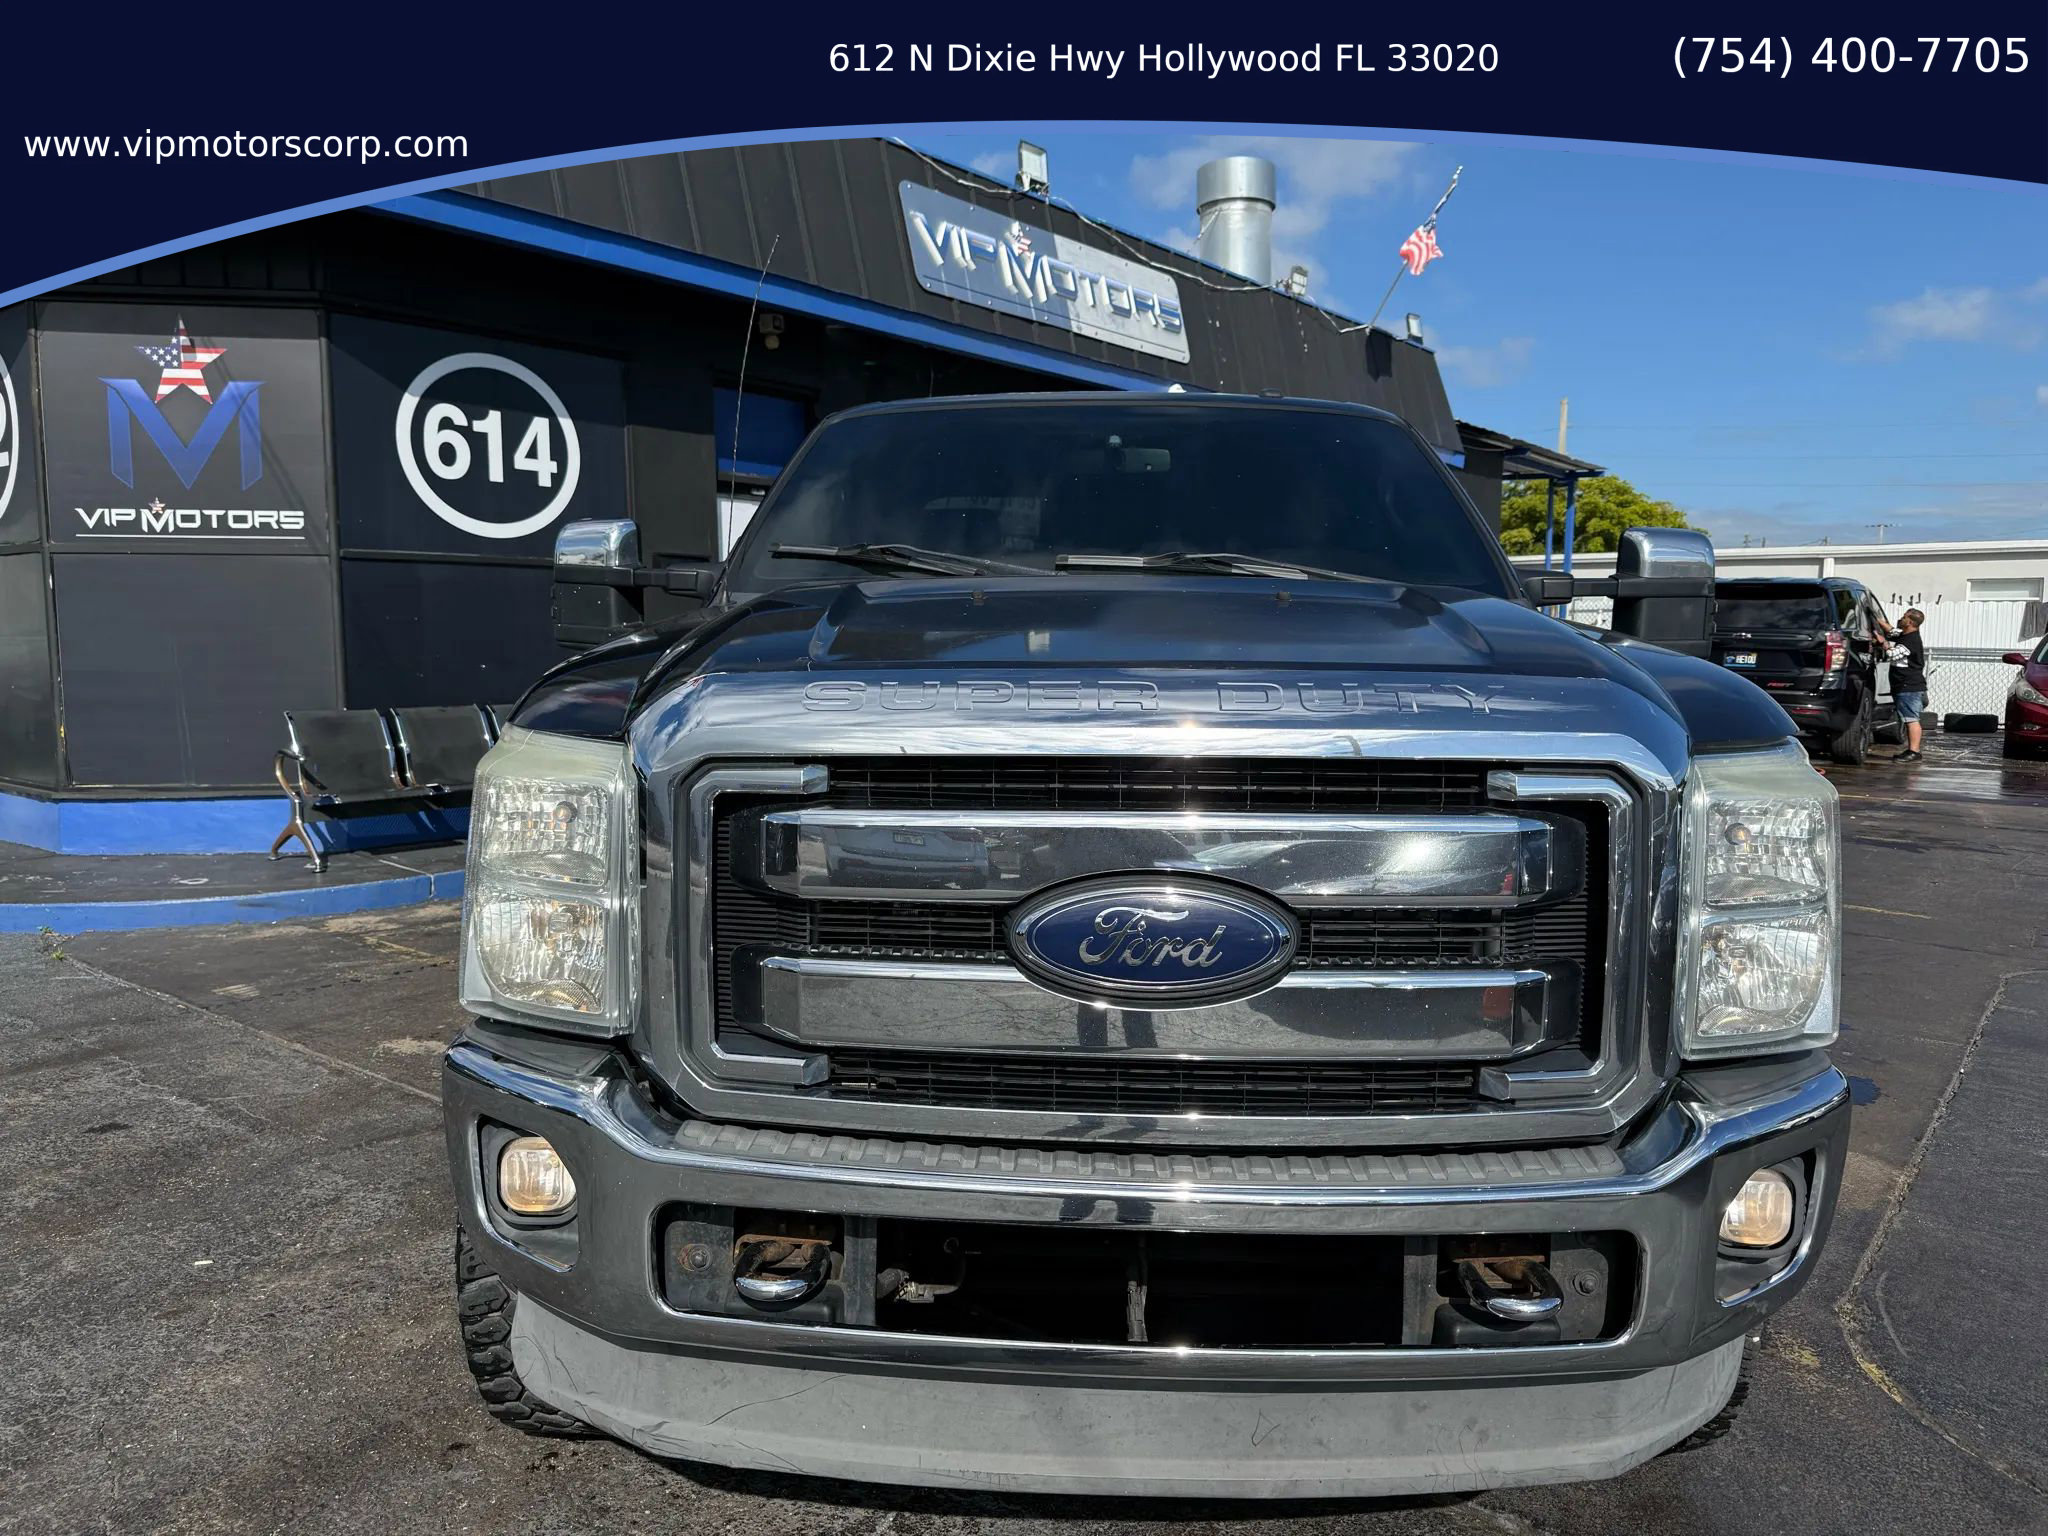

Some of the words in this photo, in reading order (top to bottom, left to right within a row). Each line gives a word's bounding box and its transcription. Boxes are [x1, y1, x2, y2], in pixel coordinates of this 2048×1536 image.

[909, 209, 998, 271] VIP
[998, 238, 1183, 335] MOTORS
[422, 402, 559, 488] 614
[74, 507, 137, 529] VIP
[139, 507, 305, 533] MOTORS
[803, 680, 1160, 712] SUPER
[1217, 681, 1506, 715] DUTY
[1078, 906, 1228, 967] Ford
